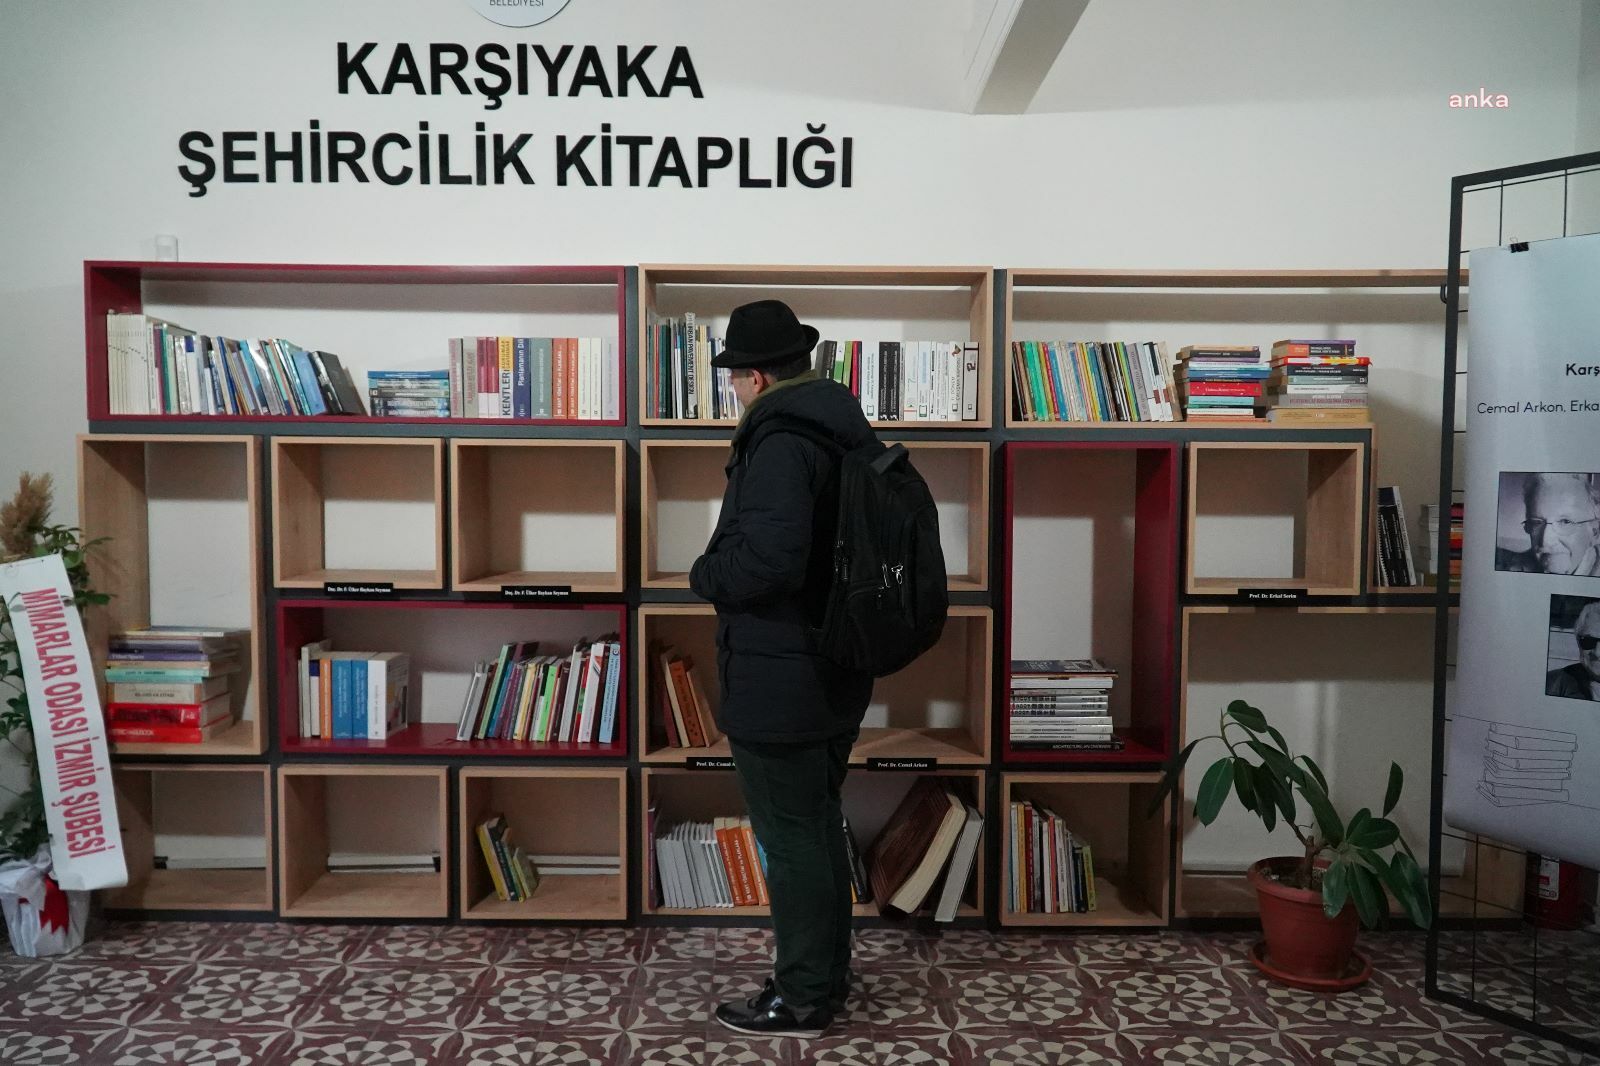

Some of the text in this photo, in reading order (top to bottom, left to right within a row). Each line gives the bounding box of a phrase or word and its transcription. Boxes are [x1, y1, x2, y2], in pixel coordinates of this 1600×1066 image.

[338, 43, 703, 110] KARŞIYAKA
[179, 120, 852, 197] ŞEHİRCİLİK KİTAPLIĞI
[1477, 402, 1520, 414] Cemal
[1523, 401, 1566, 413] Arkon,
[44, 681, 88, 739] ODASI
[54, 735, 104, 793] İZMİR
[52, 790, 116, 858] ŞUBESİ
